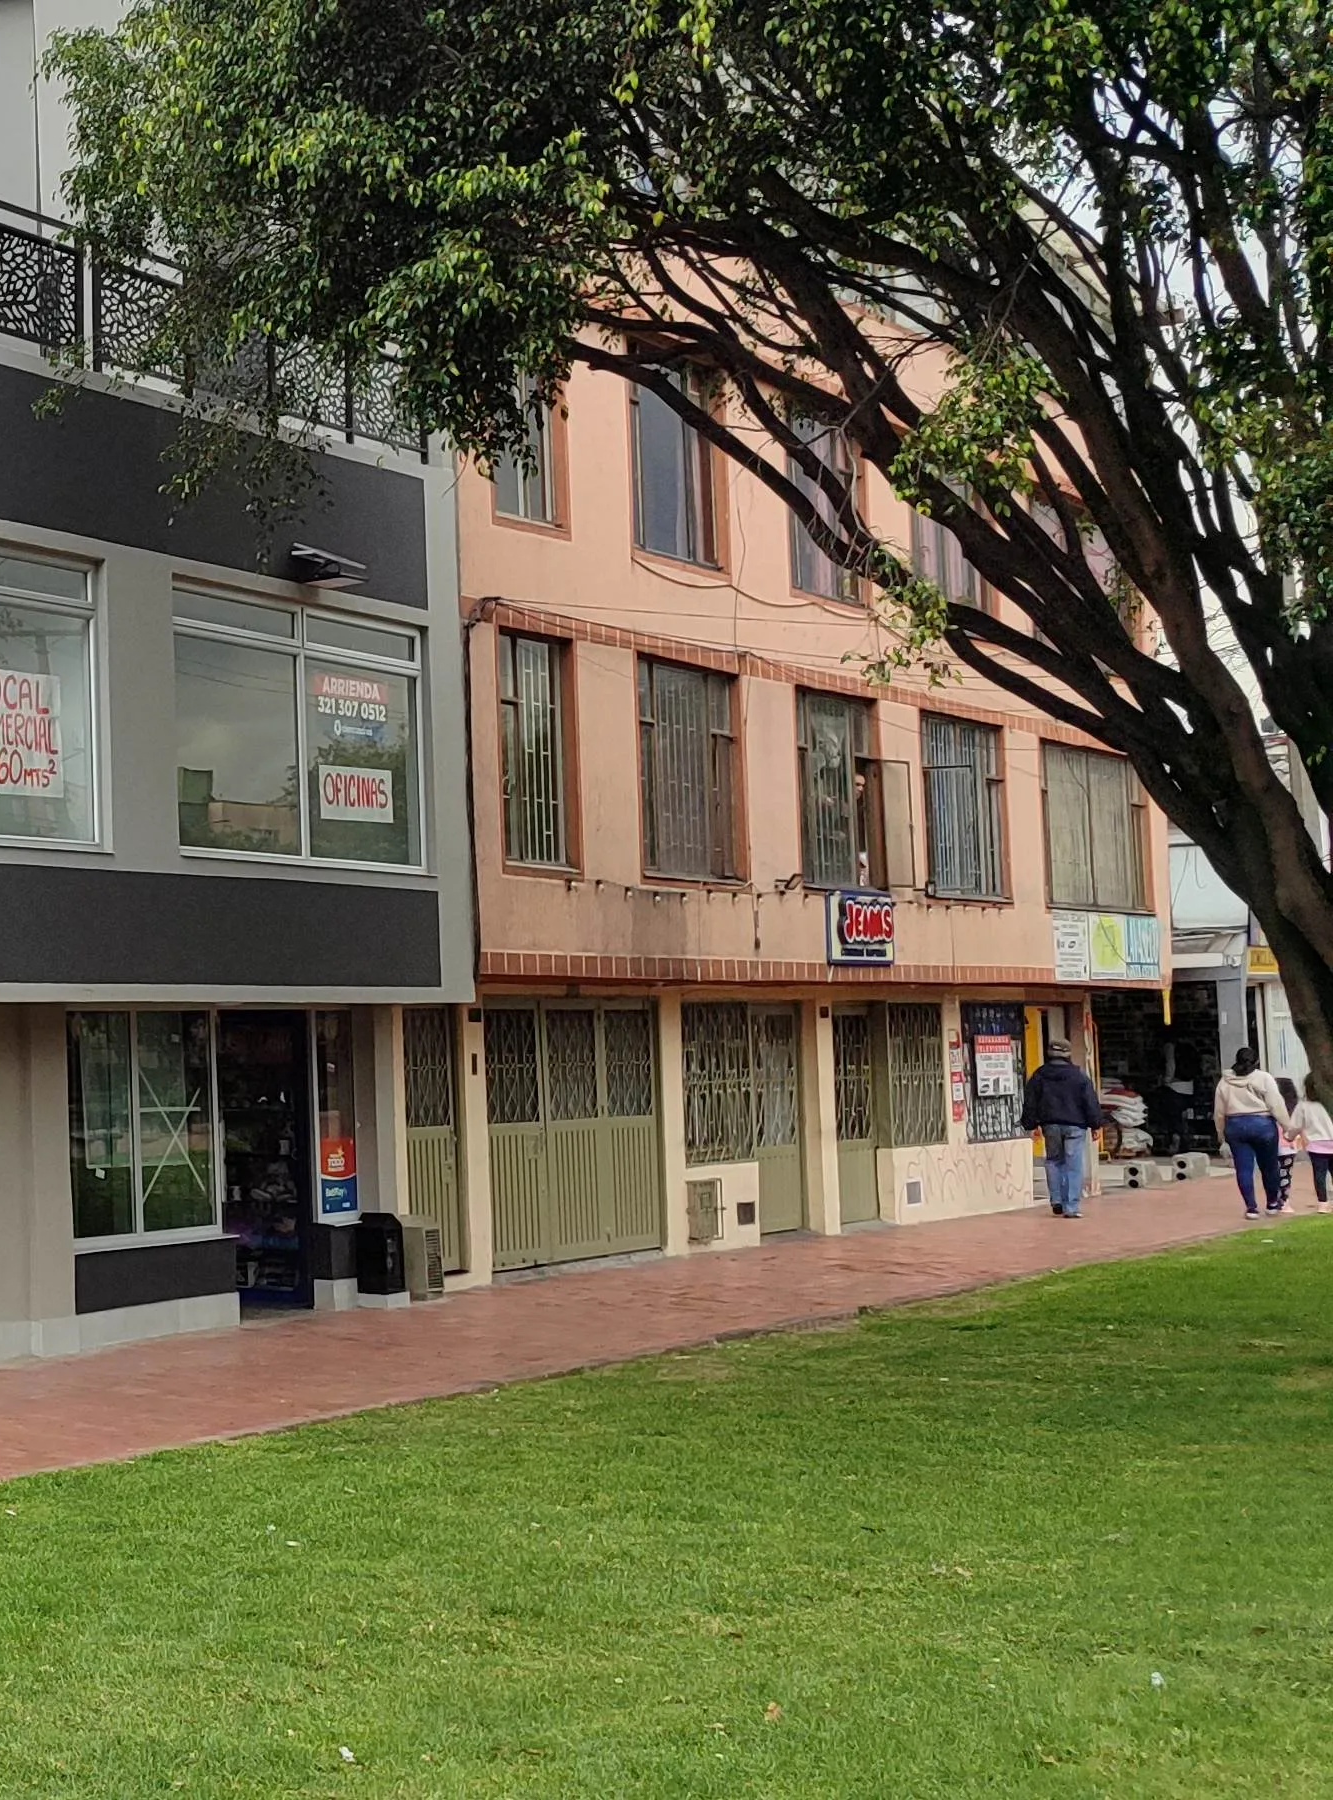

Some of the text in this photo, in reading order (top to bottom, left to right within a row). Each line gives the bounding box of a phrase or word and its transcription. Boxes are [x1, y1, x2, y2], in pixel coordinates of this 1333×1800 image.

[322, 675, 380, 700] ARRIENDA
[317, 696, 386, 721] 321 307 0512
[323, 772, 389, 809] OFICINAS
